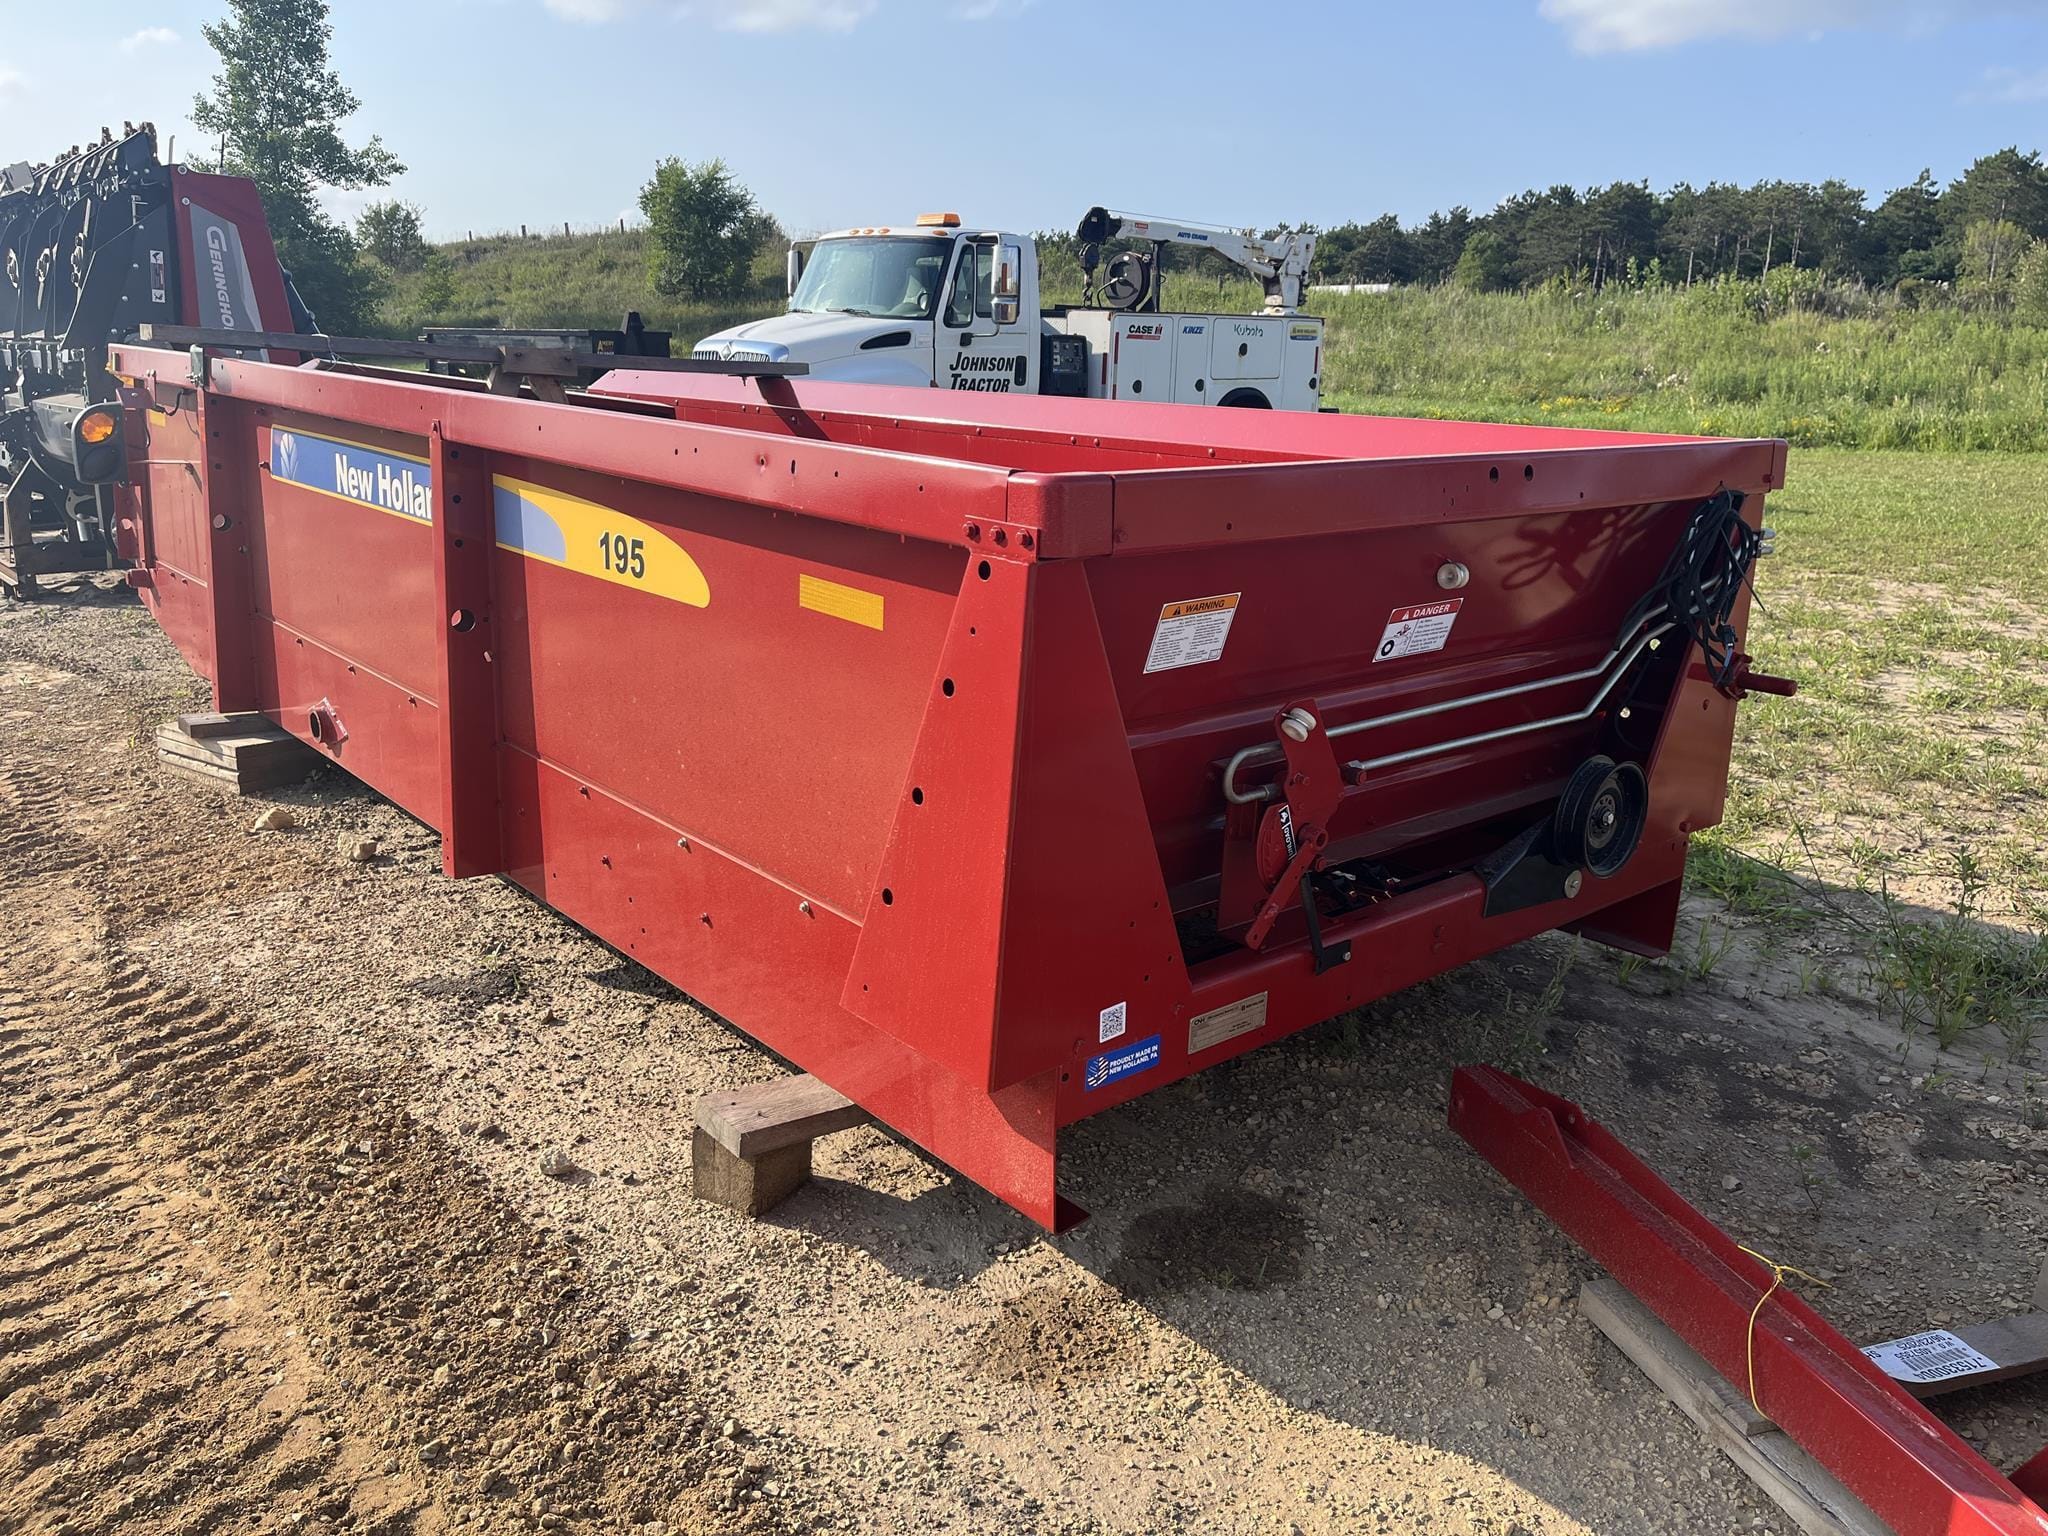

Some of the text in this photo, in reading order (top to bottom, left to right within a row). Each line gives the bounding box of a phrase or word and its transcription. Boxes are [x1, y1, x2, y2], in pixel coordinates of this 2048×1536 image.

[205, 225, 235, 330] GERINGHO
[1128, 324, 1154, 335] CASE
[1182, 325, 1205, 335] KINZE
[1233, 324, 1264, 337] Kubota
[949, 351, 1015, 372] JOHNSON
[950, 373, 1010, 393] TRACTOR
[335, 452, 433, 520] New Holla
[598, 530, 646, 579] 195
[1185, 599, 1225, 613] WARNING
[1412, 604, 1451, 618] DANGER
[1109, 1044, 1158, 1068] PROUDLY MADE IN
[1109, 1051, 1158, 1075] NEW HOLLAND, PA
